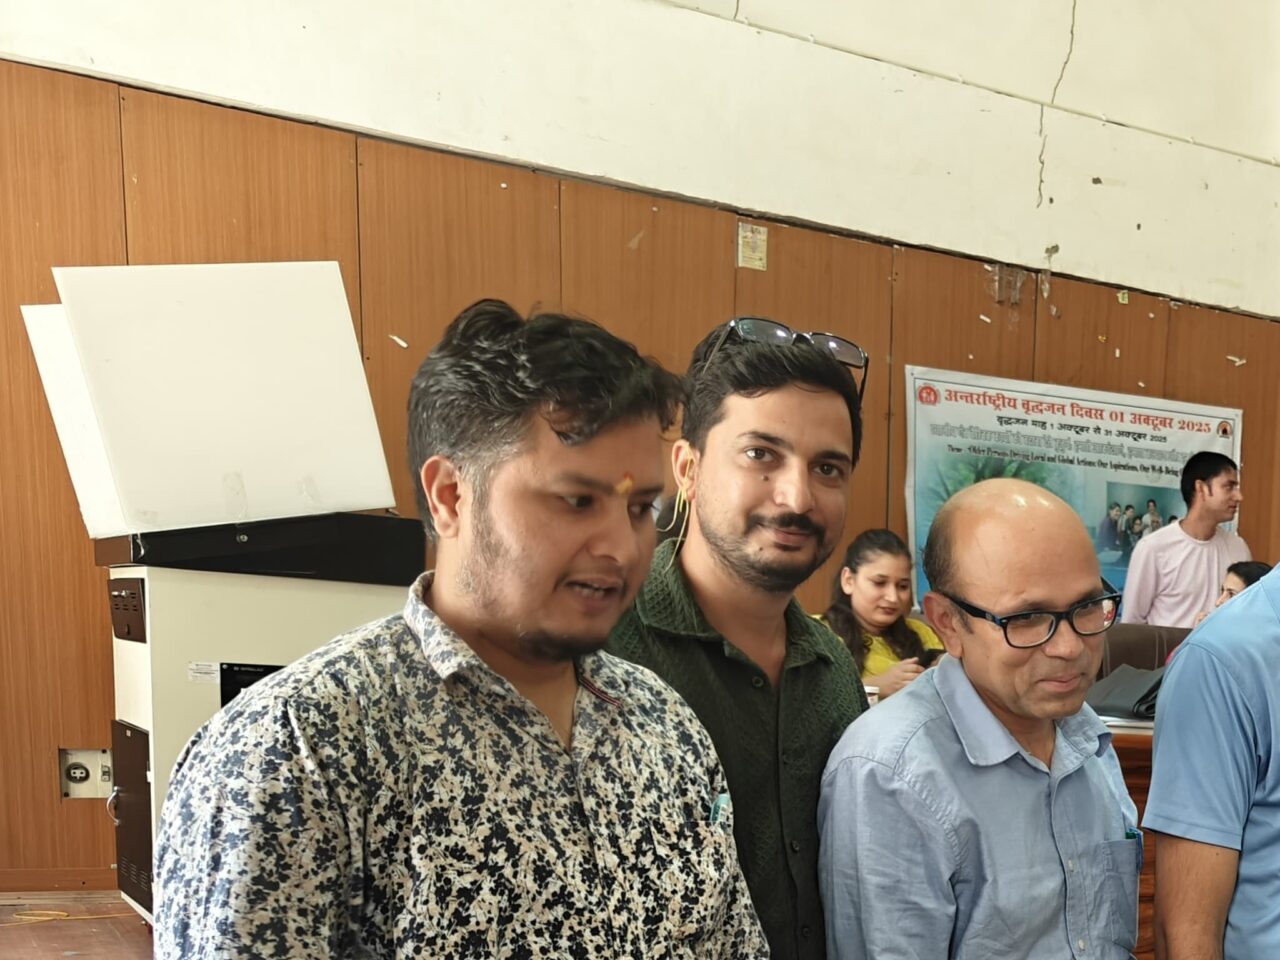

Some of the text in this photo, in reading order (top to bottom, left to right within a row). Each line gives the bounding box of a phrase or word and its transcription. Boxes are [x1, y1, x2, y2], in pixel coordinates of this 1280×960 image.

[944, 389, 1211, 433] अन्तर्राष्ट्रीय वृद्धजन दिवस 01 अक्टूबर 2025
[1057, 422, 1090, 434] अक्टूबर
[1094, 426, 1101, 435] से
[1115, 430, 1147, 442] अक्टूबर
